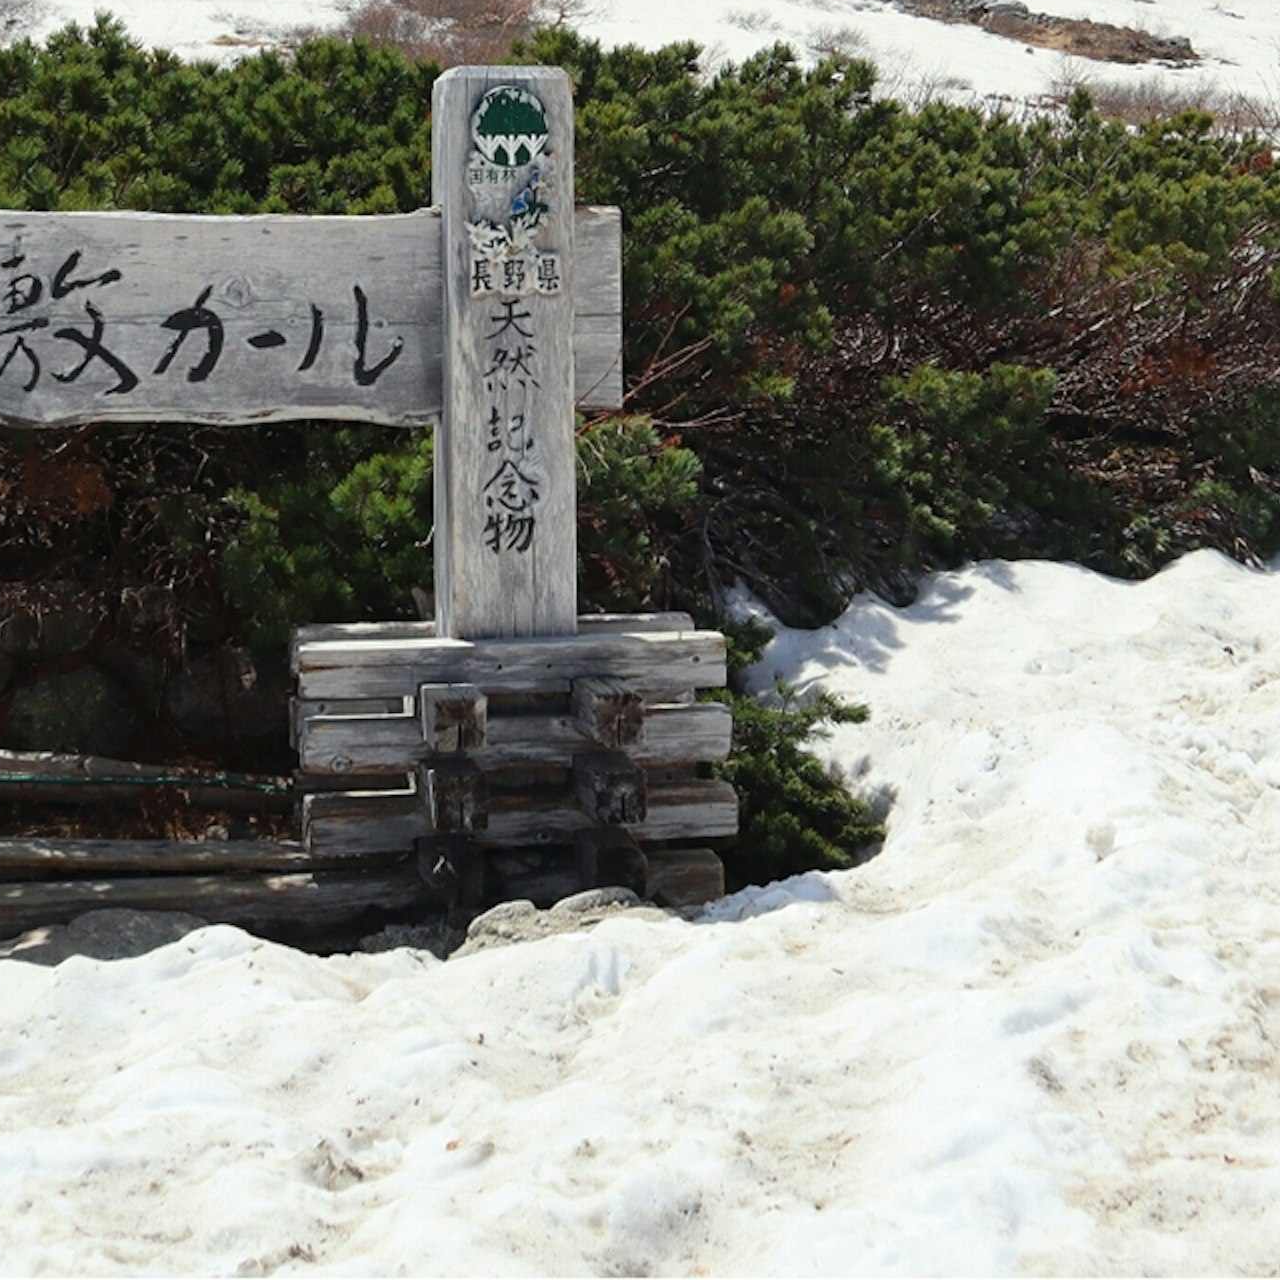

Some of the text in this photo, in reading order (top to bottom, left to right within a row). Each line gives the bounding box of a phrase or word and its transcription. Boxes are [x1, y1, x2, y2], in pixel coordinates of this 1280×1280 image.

[469, 168, 517, 185] 国有林
[472, 258, 560, 291] 長野県
[483, 299, 541, 554] 天然記念物
